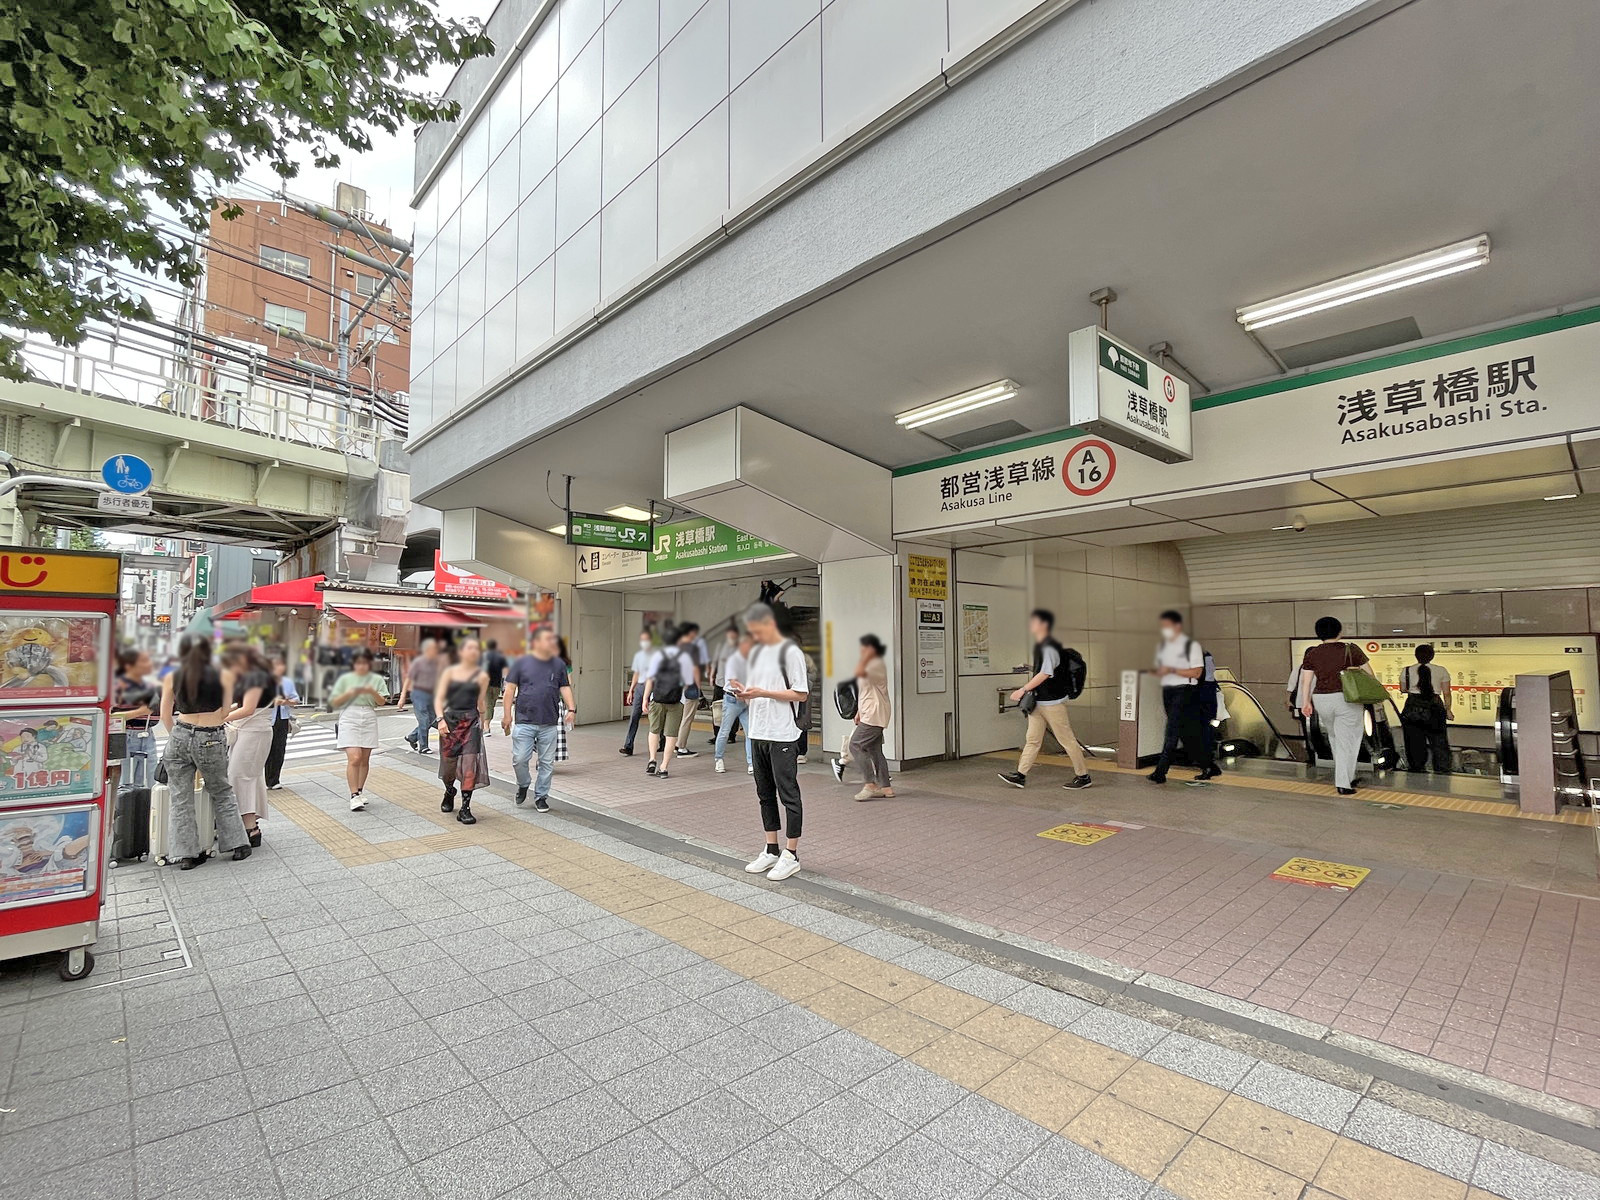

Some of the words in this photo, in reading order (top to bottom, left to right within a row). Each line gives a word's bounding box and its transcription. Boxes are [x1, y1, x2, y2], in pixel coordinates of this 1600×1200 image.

[1337, 355, 1538, 426] 浅草橋駅
[1128, 389, 1168, 427] 浅草橋駅
[1126, 411, 1161, 436] Asakusabashi
[1161, 427, 1171, 440] Sta.
[1341, 404, 1491, 445] Asakusabashi
[1499, 398, 1548, 418] Sta.
[1082, 449, 1096, 466] A
[940, 455, 1056, 500] 都営浅草線
[1077, 465, 1102, 484] 16
[103, 496, 150, 509] 歩行者優先
[940, 495, 985, 512] Asakusa
[988, 491, 1013, 504] Line
[617, 527, 636, 540] JR
[675, 525, 716, 548] 浅草橋駅
[736, 533, 749, 543] East
[652, 534, 671, 555] JR
[675, 546, 709, 560] Asakusabashi
[709, 543, 728, 556] Station
[931, 613, 941, 622] A3
